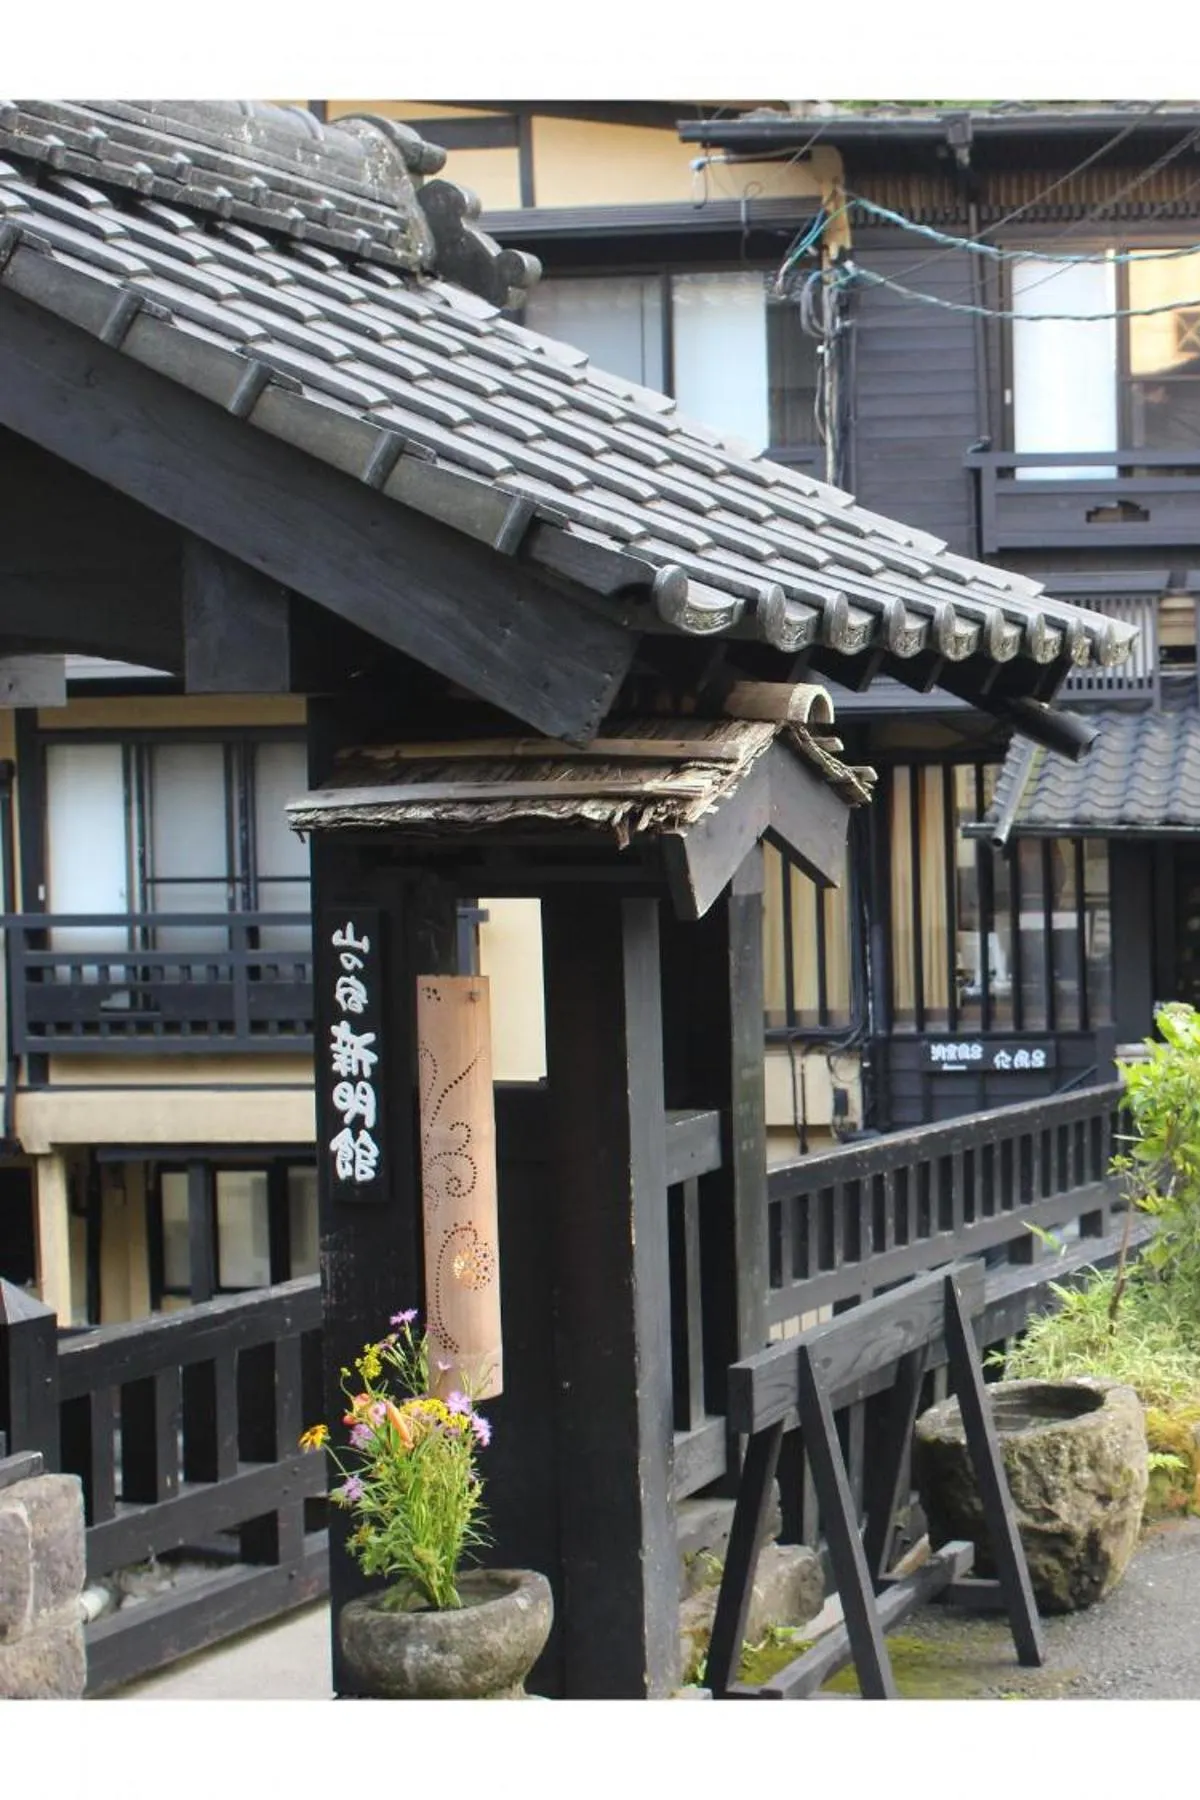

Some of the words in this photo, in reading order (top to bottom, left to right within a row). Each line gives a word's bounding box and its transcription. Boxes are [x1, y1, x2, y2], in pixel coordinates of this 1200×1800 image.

[331, 921, 371, 1014] 山の宿
[329, 1020, 380, 1184] 新明館
